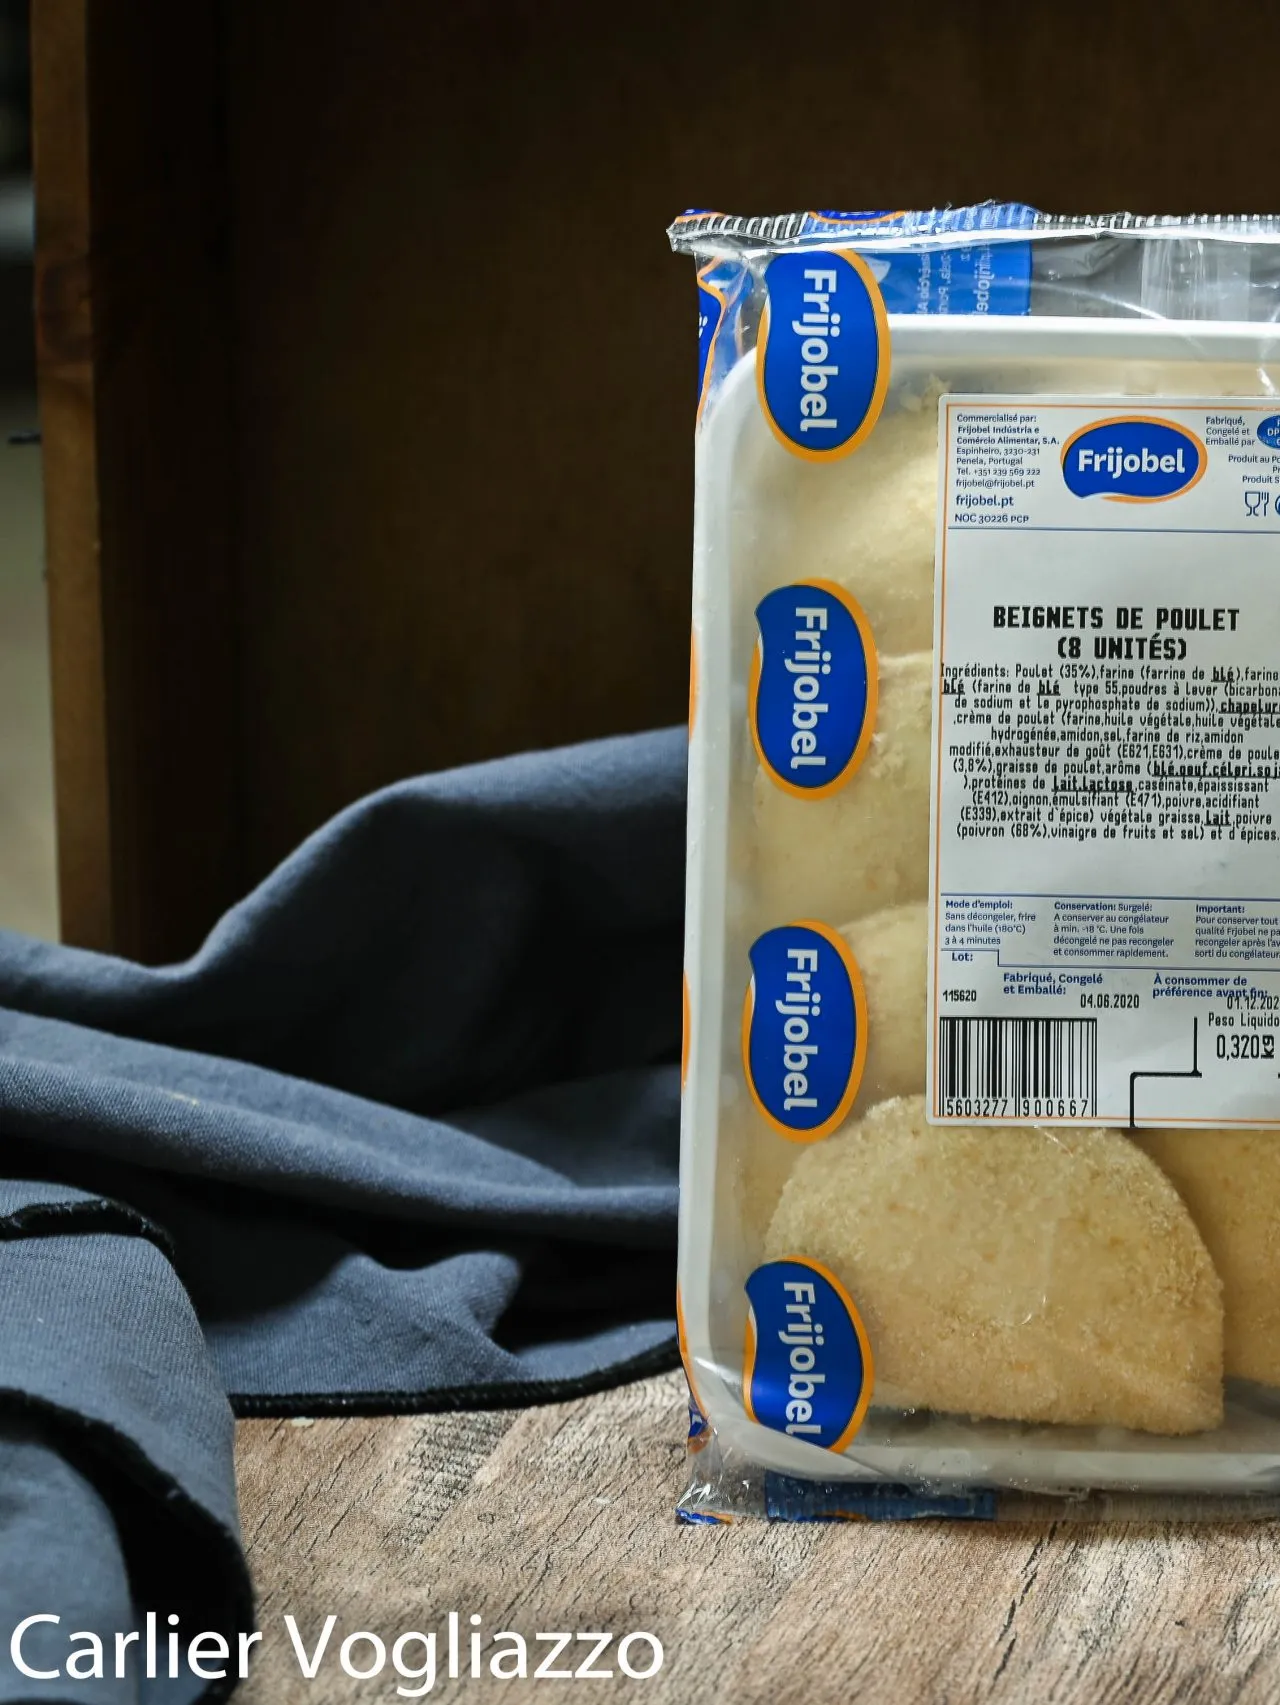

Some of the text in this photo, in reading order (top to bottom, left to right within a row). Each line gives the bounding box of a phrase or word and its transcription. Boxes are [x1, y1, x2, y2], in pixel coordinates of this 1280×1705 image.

[792, 269, 841, 432] Frijobel
[957, 413, 1036, 424] Commercialisé par:
[1206, 417, 1245, 426] Fabriqué,
[958, 426, 990, 434] Frijobel
[993, 426, 1032, 434] Indústria
[1206, 428, 1239, 436] Congelé
[1241, 439, 1255, 447] par
[957, 458, 1022, 466] Penela, Portugal
[1078, 446, 1185, 479] Frijobel
[1228, 455, 1258, 463] Produit
[993, 468, 1007, 476] 239
[956, 479, 1034, 489] frijobel@frijobel.pt
[956, 494, 1013, 508] frijobel.pt
[955, 514, 976, 522] NOC
[979, 514, 1008, 524] 30226
[994, 606, 1239, 631] BEIGNETS DE POULET
[1058, 632, 1187, 660] (8 UNITÉS)
[941, 664, 1009, 679] Ingrédients:
[1016, 664, 1053, 678] Poulet
[1192, 667, 1204, 680] de
[785, 607, 831, 769] Frijobel
[972, 681, 1011, 693] (farine
[1018, 680, 1030, 692] de
[1037, 680, 1060, 696] blé
[1074, 681, 1099, 696] type
[1174, 682, 1179, 695] à
[955, 697, 967, 708] de
[974, 698, 1012, 709] sodium
[1020, 698, 1031, 708] et
[1056, 698, 1140, 712] pyrophosphate
[1147, 698, 1159, 711] de
[998, 712, 1011, 724] de
[1018, 712, 1054, 727] poulet
[1167, 729, 1179, 742] de
[1067, 744, 1079, 757] de
[1086, 744, 1111, 760] goût
[1229, 746, 1241, 759] de
[1045, 761, 1057, 773] de
[1033, 778, 1045, 789] de
[1100, 809, 1152, 825] végétale
[957, 825, 1004, 839] (poivron
[1104, 826, 1116, 838] de
[1123, 826, 1156, 839] fruits
[1162, 827, 1174, 839] et
[1181, 827, 1204, 840] sel)
[1211, 828, 1222, 839] et
[946, 900, 969, 908] Mode
[1054, 902, 1116, 911] Conservation:
[1196, 905, 1244, 914] Important:
[967, 912, 1016, 923] décongeler,
[1018, 913, 1036, 921] frire
[1118, 915, 1168, 924] congélateur
[1061, 925, 1079, 933] min.
[1129, 926, 1143, 934] fois
[1195, 927, 1224, 936] qualité
[1054, 937, 1097, 946] décongelé
[1112, 939, 1126, 949] pas
[1129, 938, 1174, 947] recongeler
[1195, 939, 1239, 948] recongeler
[1242, 939, 1265, 948] après
[952, 952, 972, 962] Lot:
[1117, 949, 1168, 959] rapidement.
[1195, 950, 1280, 960] sorti du congélateur.
[1003, 972, 1102, 986] Fabriqué, Congelé
[1165, 976, 1247, 986] consommer de
[1003, 985, 1066, 995] et Emballé:
[1153, 987, 1247, 999] préférence avant
[943, 990, 977, 1002] 115620
[1080, 994, 1140, 1008] 04.06.2020
[1209, 1011, 1234, 1026] Peso
[775, 949, 821, 1110] Frijobel
[946, 1099, 1089, 1118] 5603277 900667
[779, 1282, 825, 1436] Frijobel
